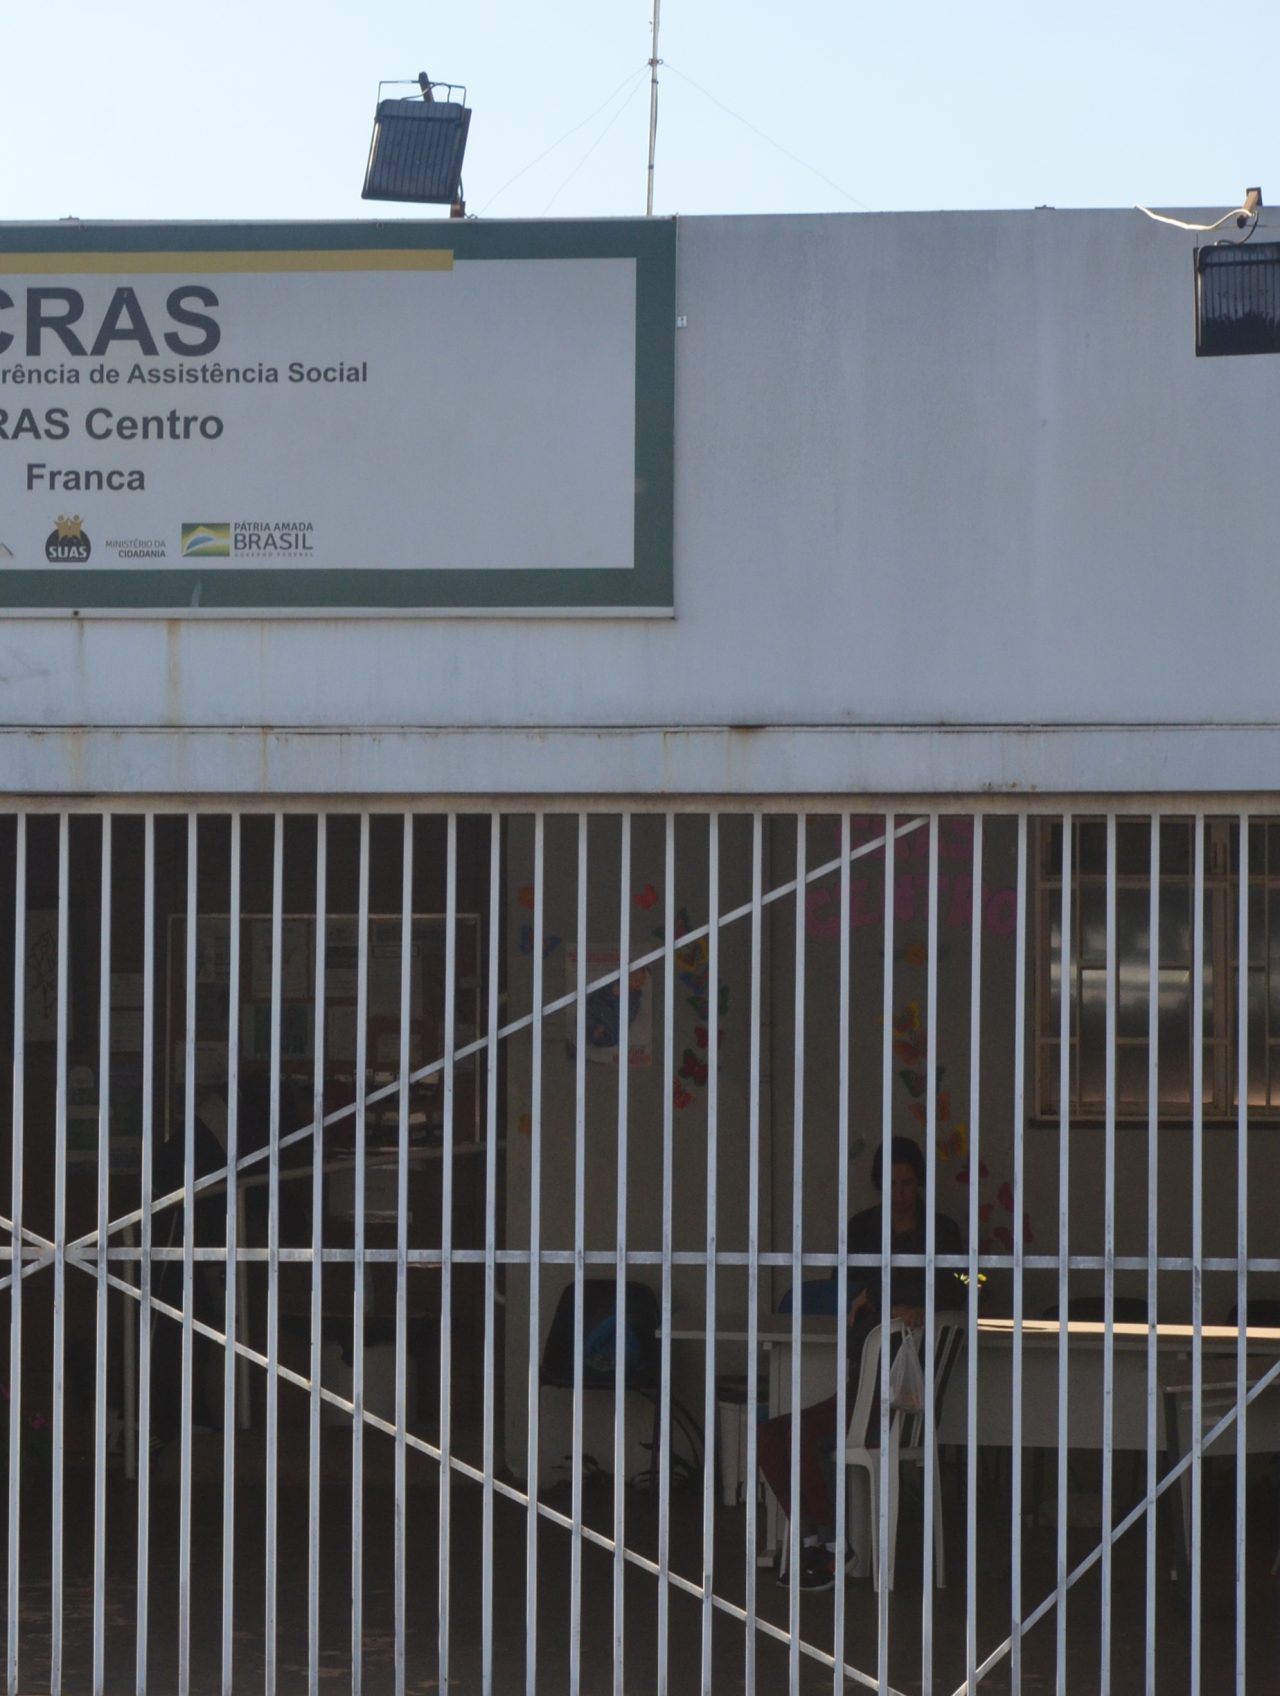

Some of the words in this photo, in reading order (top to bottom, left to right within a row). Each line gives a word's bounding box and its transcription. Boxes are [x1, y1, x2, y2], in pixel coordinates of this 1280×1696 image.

[89, 363, 120, 385] de
[127, 361, 278, 384] Assistência
[288, 362, 368, 383] Social
[85, 407, 224, 440] Centro
[26, 463, 146, 491] Franca
[234, 521, 271, 532] PÁTRIA
[274, 522, 314, 532] AMADA
[105, 538, 152, 549] MINISTÉRIO
[154, 540, 166, 549] DA
[234, 533, 314, 551] BRASIL
[49, 546, 88, 558] SUAS
[118, 550, 166, 559] CIDADANIA
